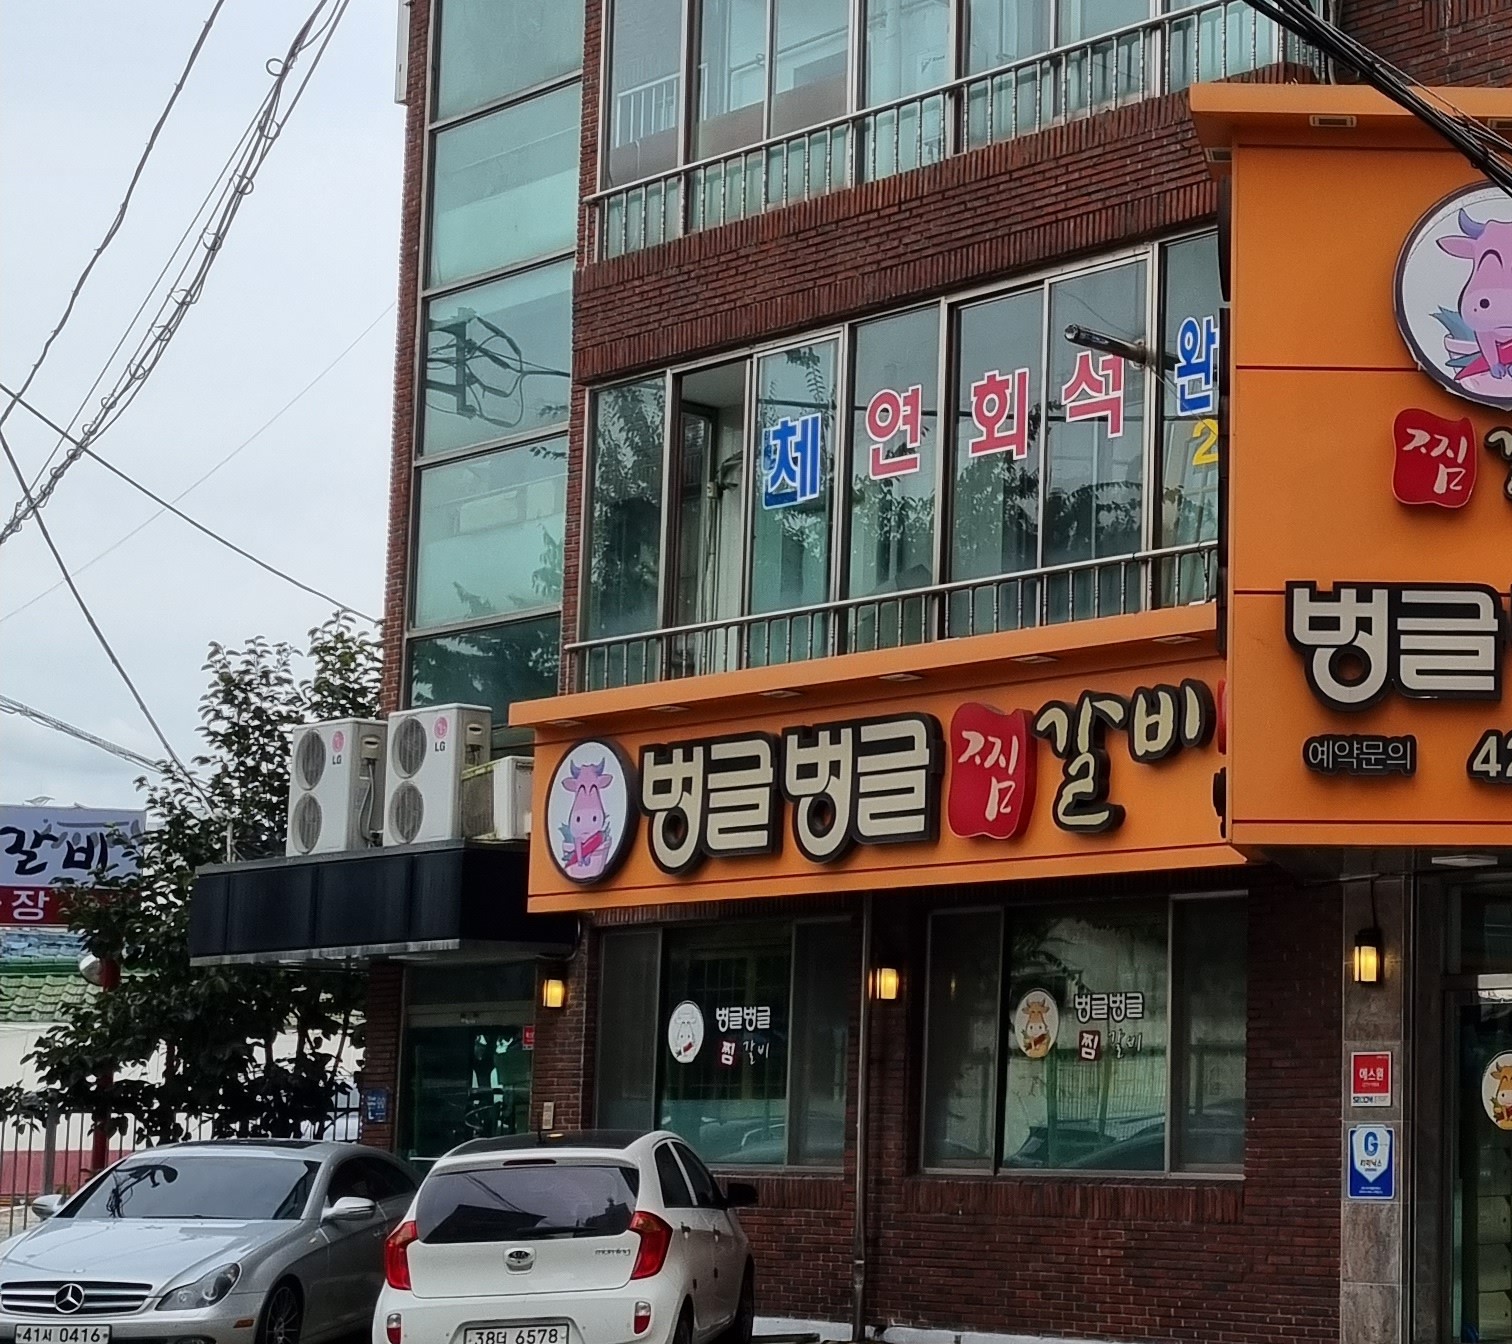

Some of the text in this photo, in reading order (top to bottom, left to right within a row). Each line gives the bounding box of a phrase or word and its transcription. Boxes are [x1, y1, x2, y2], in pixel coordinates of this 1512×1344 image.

[434, 741, 446, 752] LG
[1307, 739, 1412, 771] 예약문의
[332, 754, 342, 765] LG
[639, 714, 937, 873] 벙글벙글
[0, 890, 50, 921] 장
[1075, 992, 1144, 1023] 벙글벙글
[716, 1006, 771, 1033] 벙글벙글
[1359, 1067, 1385, 1082] 에스원
[59, 1327, 101, 1343] 0416
[515, 1328, 558, 1344] 6578
